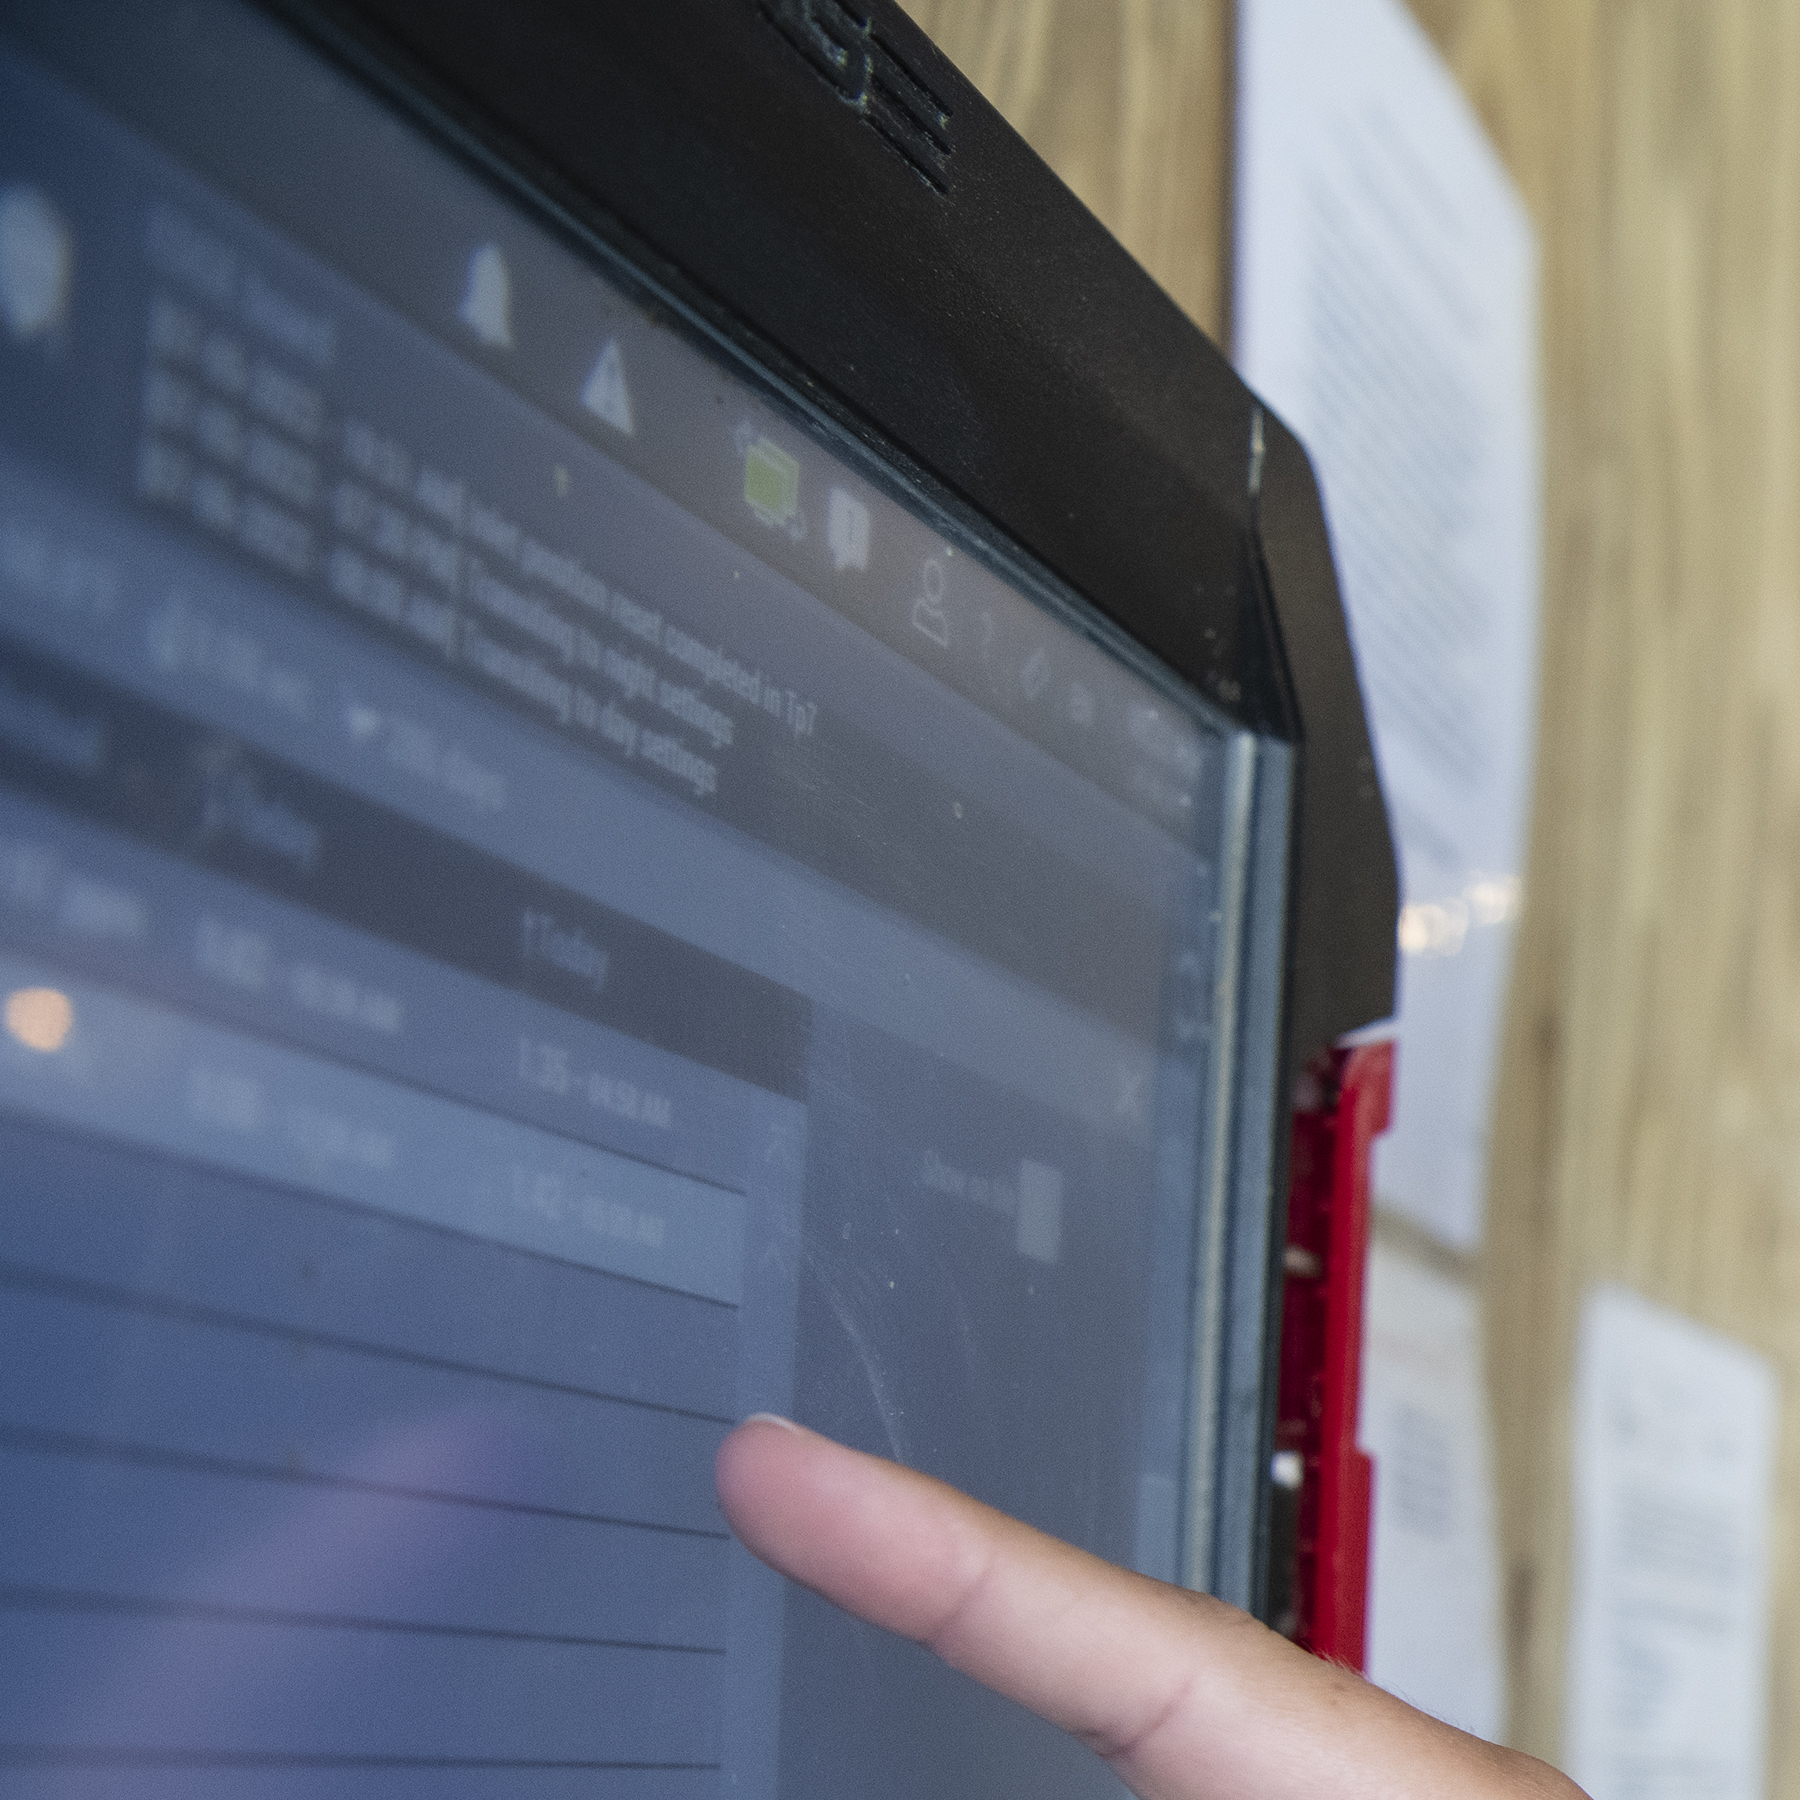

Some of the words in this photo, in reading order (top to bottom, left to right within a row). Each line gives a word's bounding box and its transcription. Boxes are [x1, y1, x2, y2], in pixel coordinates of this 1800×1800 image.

[664, 622, 761, 706] completed
[763, 674, 781, 718] in
[658, 679, 735, 750] settings
[639, 727, 718, 797] settings
